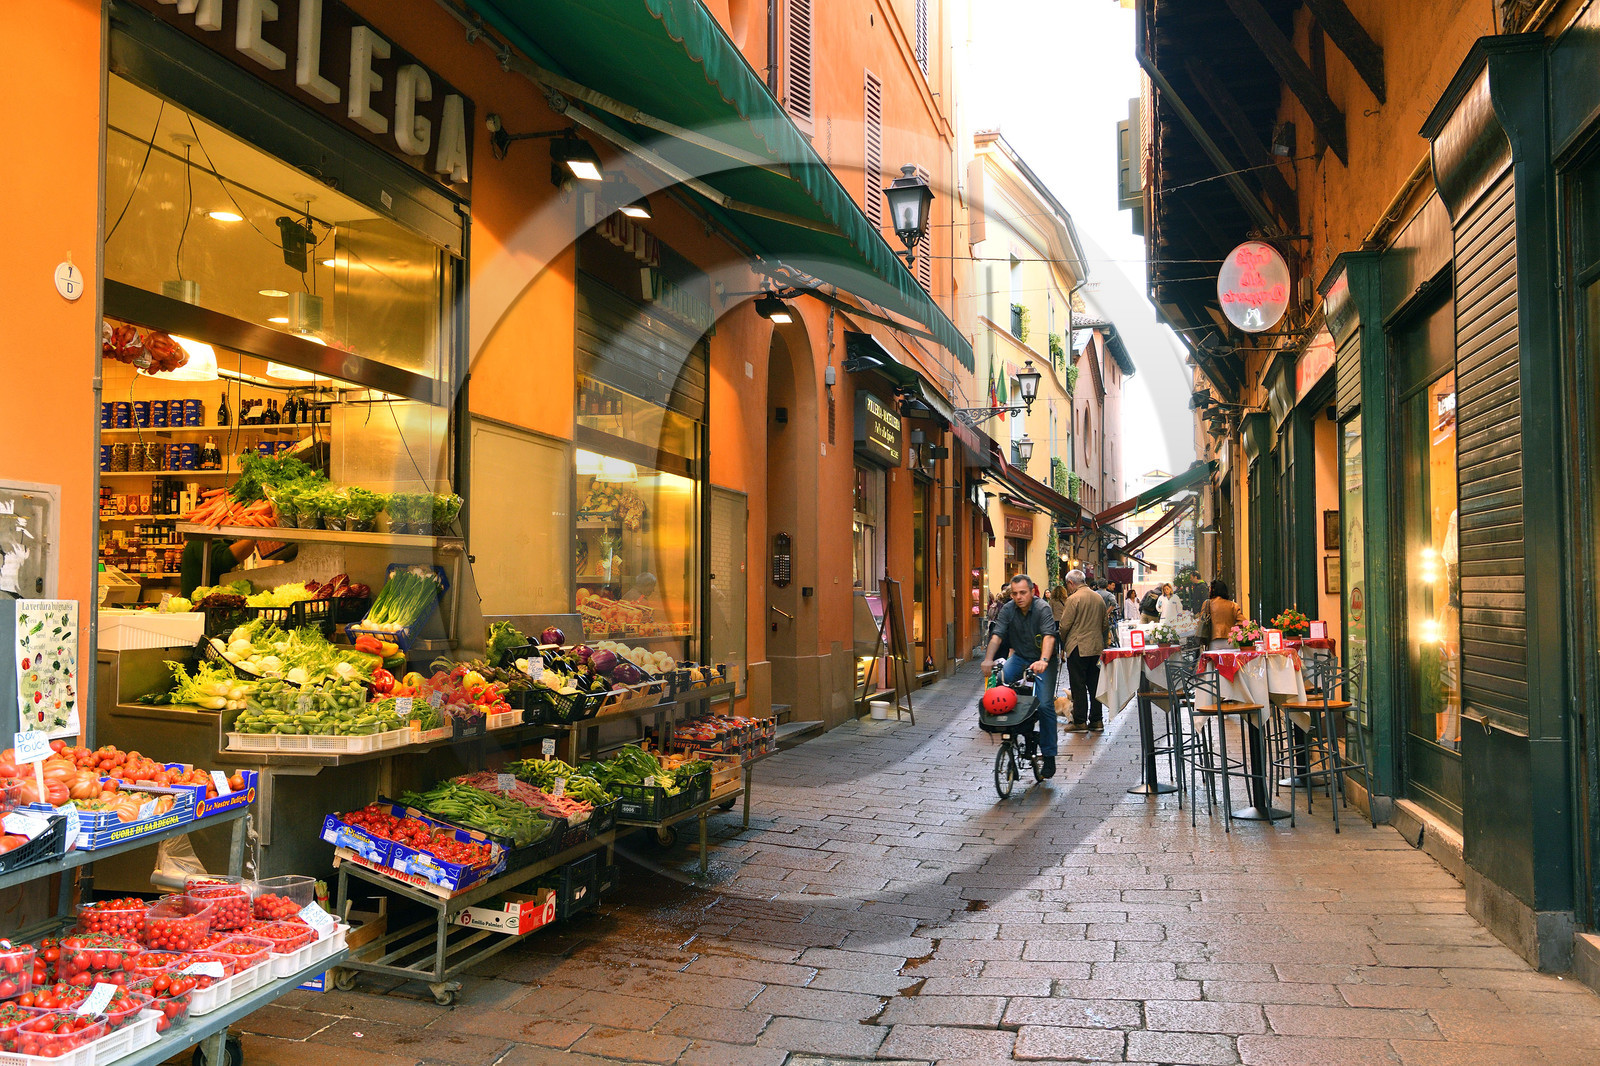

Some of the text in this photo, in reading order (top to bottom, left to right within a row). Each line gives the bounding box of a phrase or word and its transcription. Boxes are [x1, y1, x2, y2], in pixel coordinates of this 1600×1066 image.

[110, 815, 180, 841] CUORE DI SARDEGNA
[373, 862, 410, 882] BOLOGNA
[471, 918, 504, 929] Emilio Palmieri
